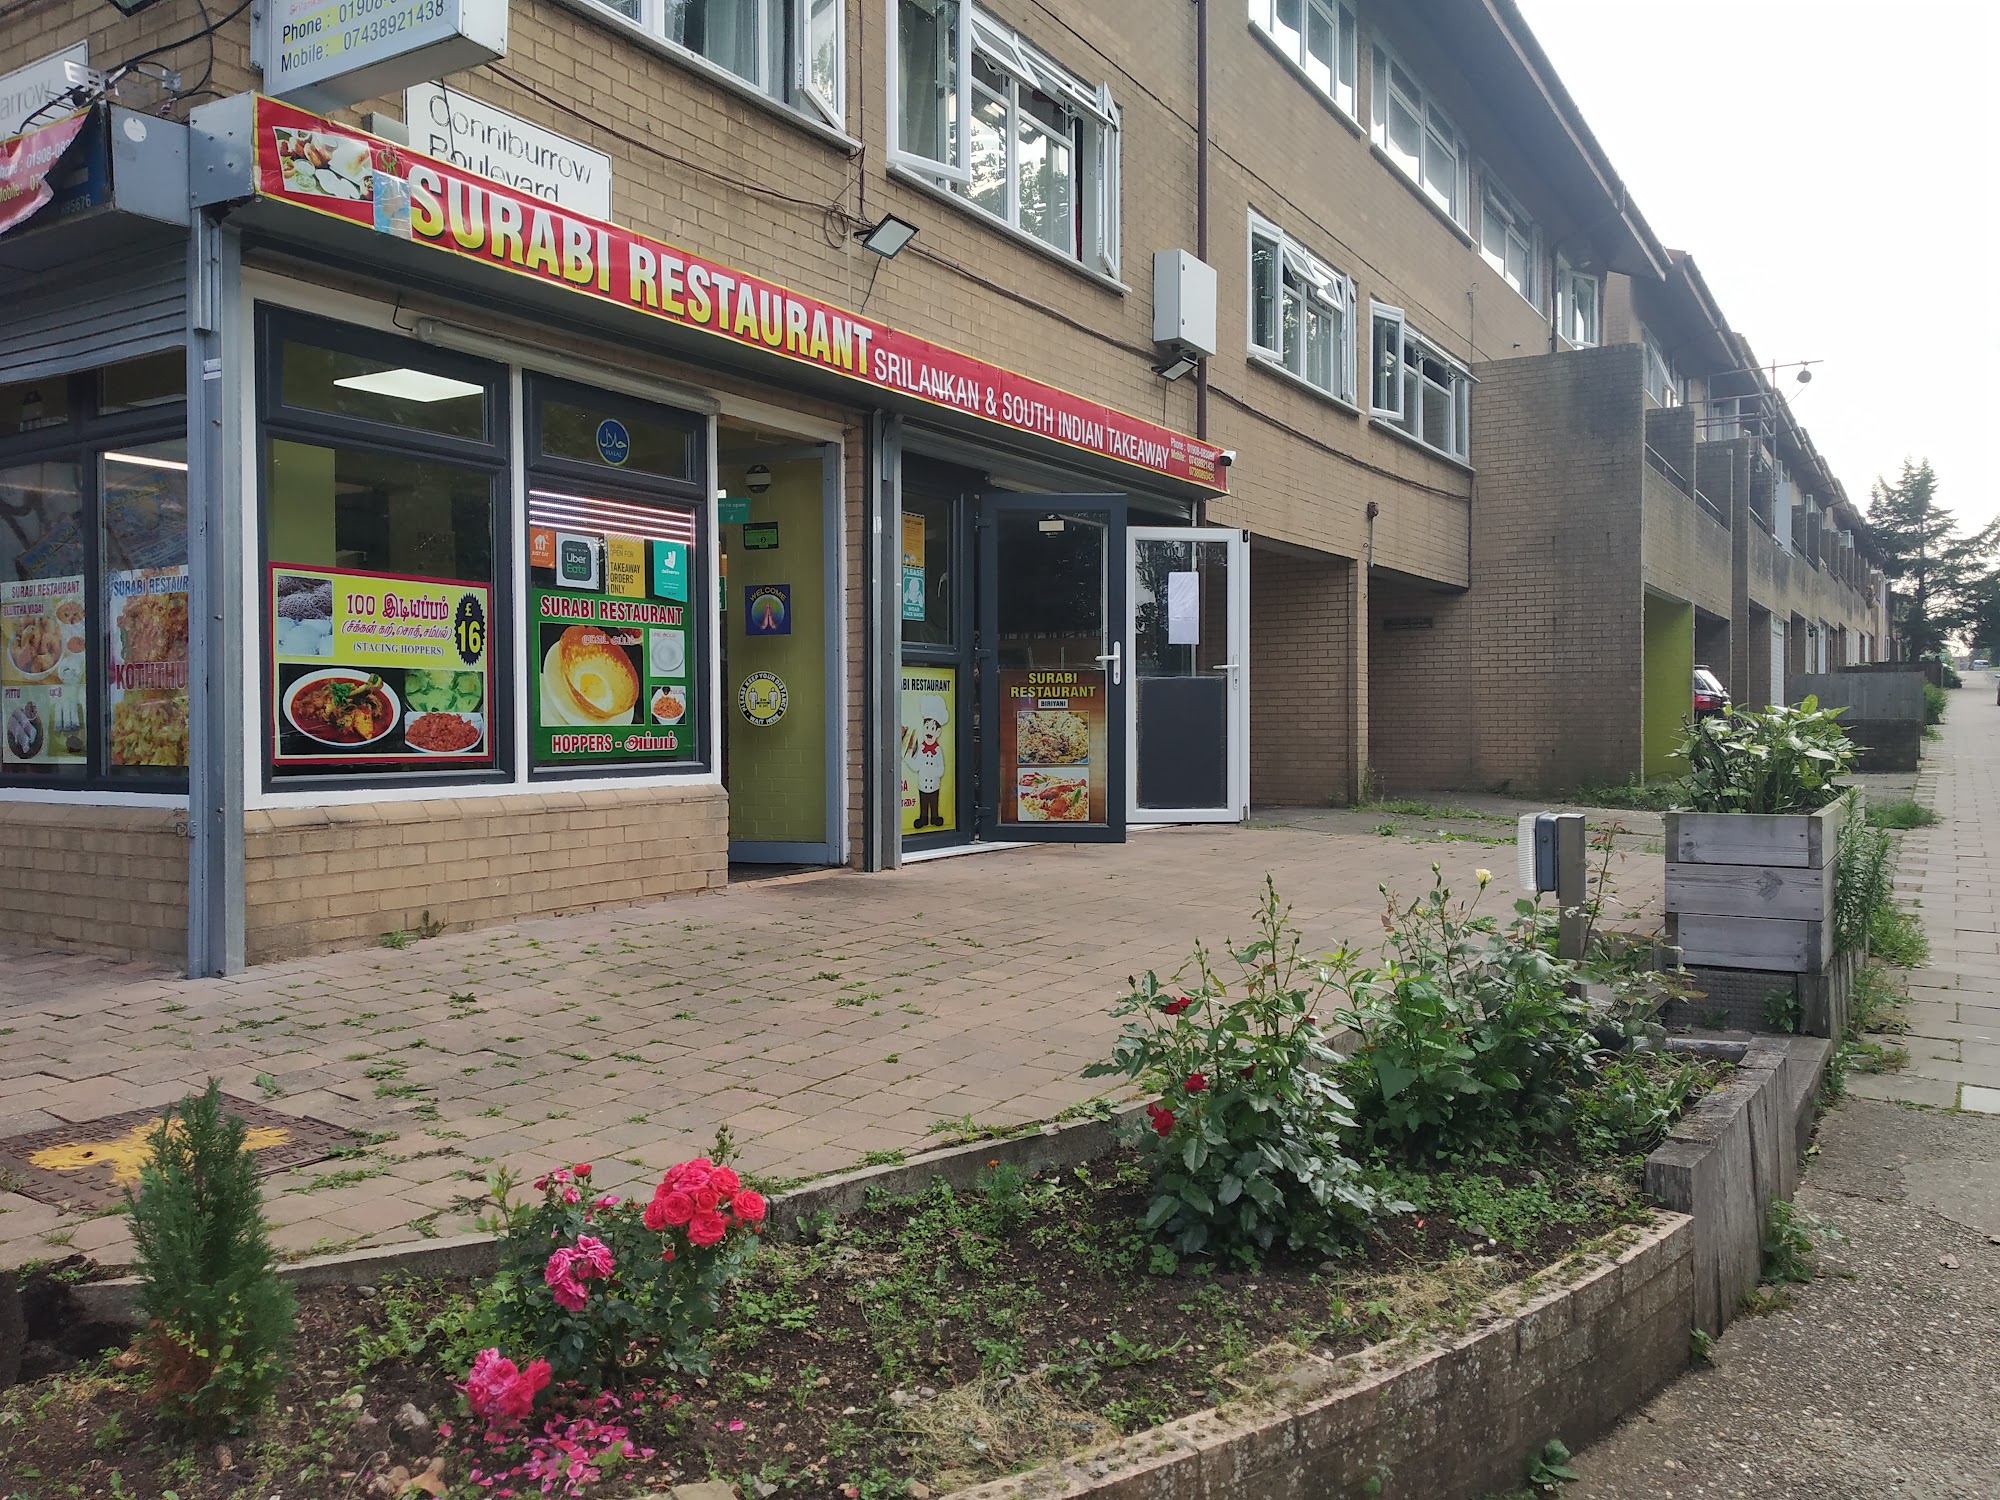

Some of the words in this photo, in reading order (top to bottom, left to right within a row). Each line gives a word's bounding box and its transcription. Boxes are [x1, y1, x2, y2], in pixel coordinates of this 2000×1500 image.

[281, 43, 329, 72] Mobile:
[343, 1, 444, 50] 07438921438
[282, 16, 322, 44] Phone
[0, 80, 51, 120] arrow
[429, 94, 592, 184] Conniburrow
[0, 160, 18, 180] hone
[408, 165, 611, 294] SURABI
[628, 241, 873, 377] RESTAURANT
[874, 348, 979, 411] SRILANKAN
[985, 386, 998, 417] &
[1002, 391, 1054, 433] SOUTH
[1058, 410, 1104, 450] INDIAN
[1107, 427, 1170, 470] TAKEAWAY
[600, 427, 628, 449] حلال
[566, 553, 586, 564] Uber
[610, 549, 623, 557] OPEN
[567, 563, 587, 574] Eats
[610, 562, 640, 573] TAKEAWAY
[903, 567, 924, 576] PLEASE
[113, 577, 146, 596] SURABI
[149, 575, 188, 594] RESTAUR
[610, 573, 634, 584] ORDERS
[11, 585, 36, 598] SURABI
[37, 580, 80, 596] RESTAURANT
[610, 583, 625, 594] ONLY
[750, 586, 787, 602] WELCOME
[346, 594, 376, 616] 100
[382, 592, 450, 621] இடியப்பம்
[464, 602, 473, 617] £
[541, 595, 595, 618] SURABI
[599, 601, 683, 625] RESTAURANT
[458, 620, 481, 653] 16
[401, 644, 444, 656] HOPPERS)
[912, 678, 951, 692] RESTAURANT
[1028, 672, 1078, 684] SURABI
[744, 675, 759, 687] KEEP
[759, 673, 776, 681] YOUR
[774, 679, 787, 711] DISTANCE
[1010, 686, 1097, 699] RESTAURANT
[749, 715, 764, 725] WAIT
[552, 735, 612, 752] HOPPERS
[625, 730, 678, 751] அப்பம்
